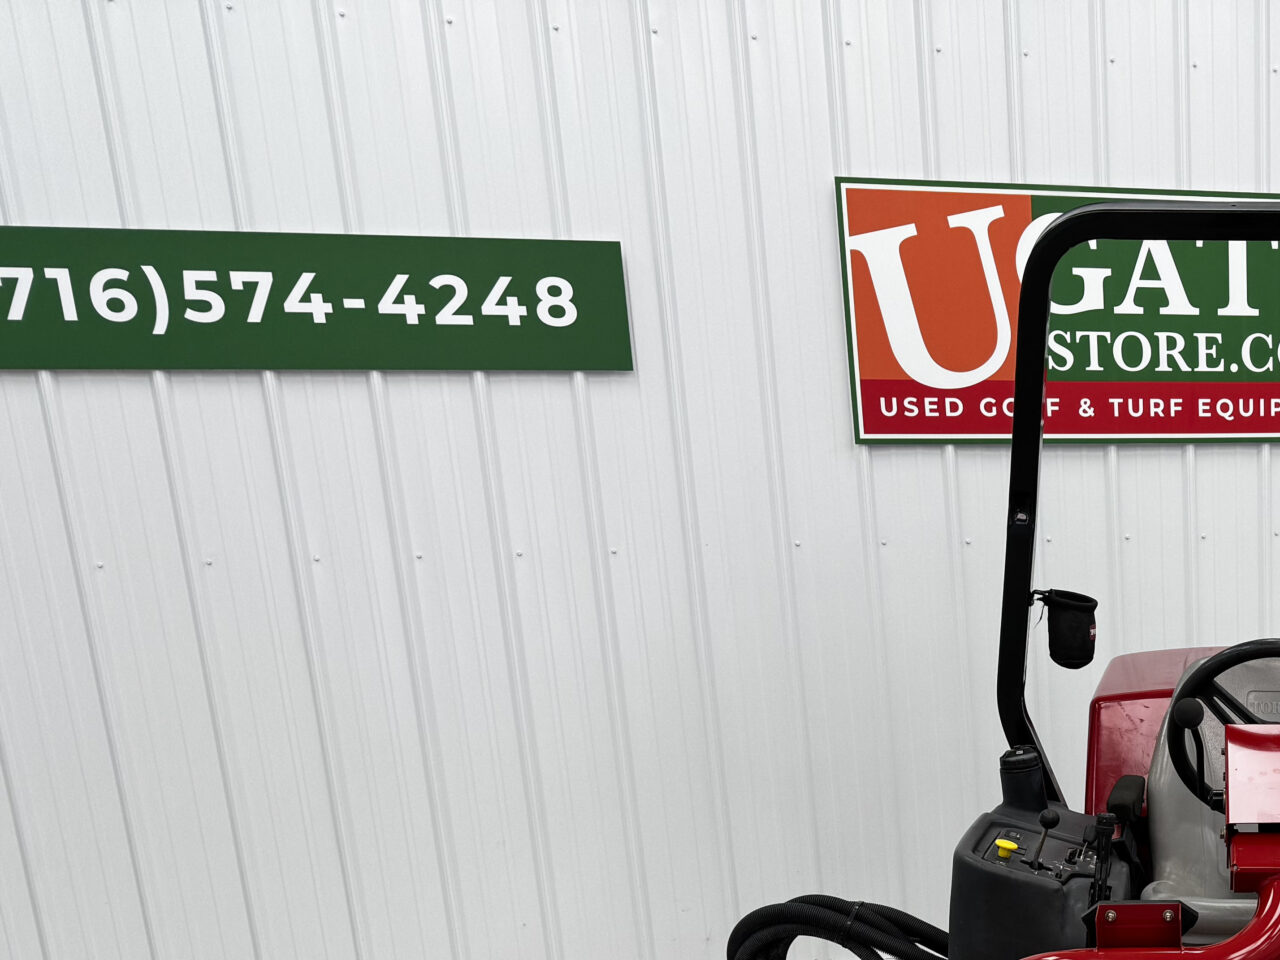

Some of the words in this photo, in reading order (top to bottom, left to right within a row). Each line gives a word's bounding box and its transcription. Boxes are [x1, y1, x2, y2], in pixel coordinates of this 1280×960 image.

[0, 265, 578, 335] 716)574-4248
[879, 397, 964, 417] USED
[979, 397, 1060, 417] GOF
[1078, 398, 1096, 417] &
[1108, 398, 1183, 417] TURF
